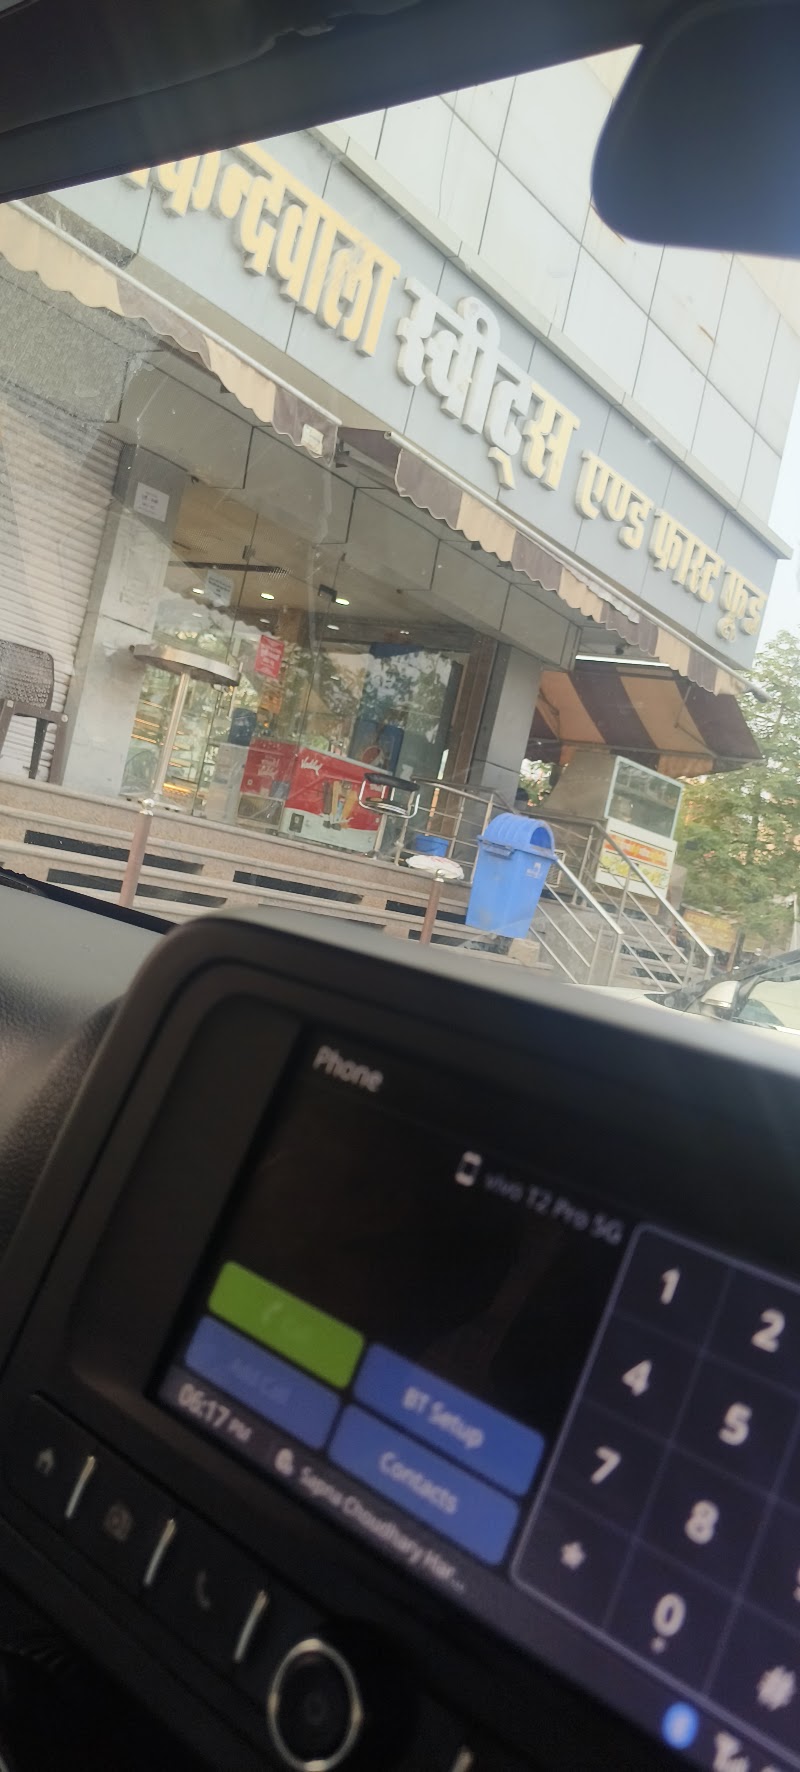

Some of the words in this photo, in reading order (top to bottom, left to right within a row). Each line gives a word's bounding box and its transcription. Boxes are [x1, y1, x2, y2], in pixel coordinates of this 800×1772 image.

[396, 277, 580, 490] स्वीट्स
[575, 450, 655, 549] एण्ड
[649, 508, 726, 603] फास्ट
[716, 566, 769, 643] फूड
[312, 1045, 383, 1093] Phone
[526, 1185, 551, 1215] T2
[553, 1197, 589, 1231] Pro
[591, 1214, 623, 1245] 5G
[660, 1267, 681, 1304] 1
[751, 1308, 785, 1353] 2
[622, 1359, 652, 1396] 4
[228, 1416, 253, 1443] PM
[403, 1386, 430, 1414] BT
[430, 1400, 484, 1450] Setup
[718, 1402, 752, 1446] 5
[380, 1451, 457, 1514] Contacts
[591, 1445, 621, 1484] 7
[685, 1500, 719, 1545] 8
[652, 1593, 686, 1638] 0
